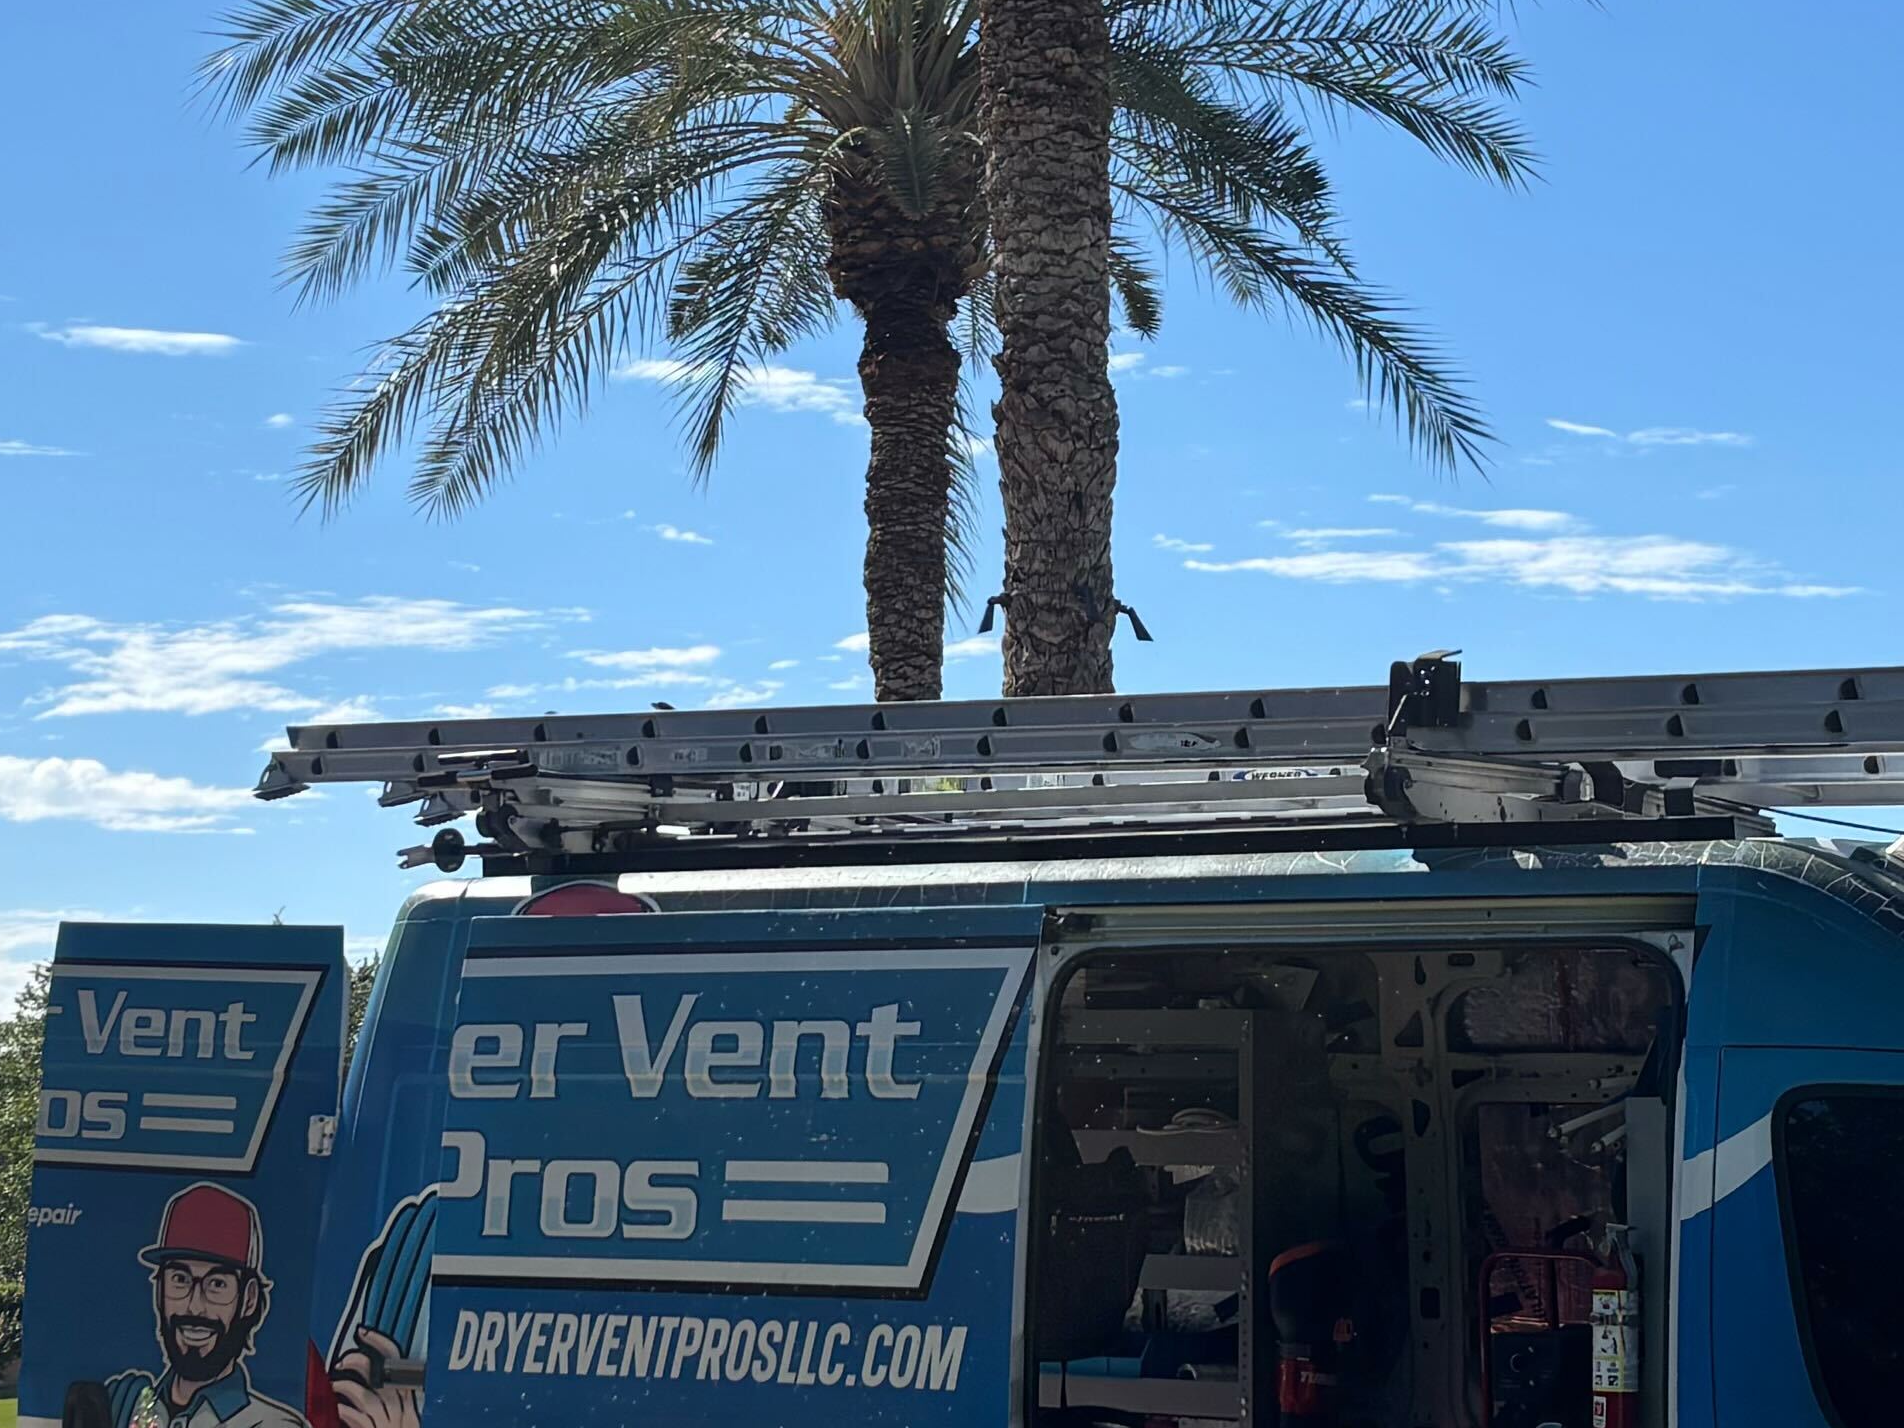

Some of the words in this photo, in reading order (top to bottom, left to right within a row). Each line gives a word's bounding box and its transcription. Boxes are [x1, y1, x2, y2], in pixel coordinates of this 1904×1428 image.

[77, 989, 257, 1060] Vent
[448, 1020, 588, 1099] er
[611, 992, 923, 1100] Vent
[448, 1310, 968, 1391] DRYERVENTPROSLLC.COM
